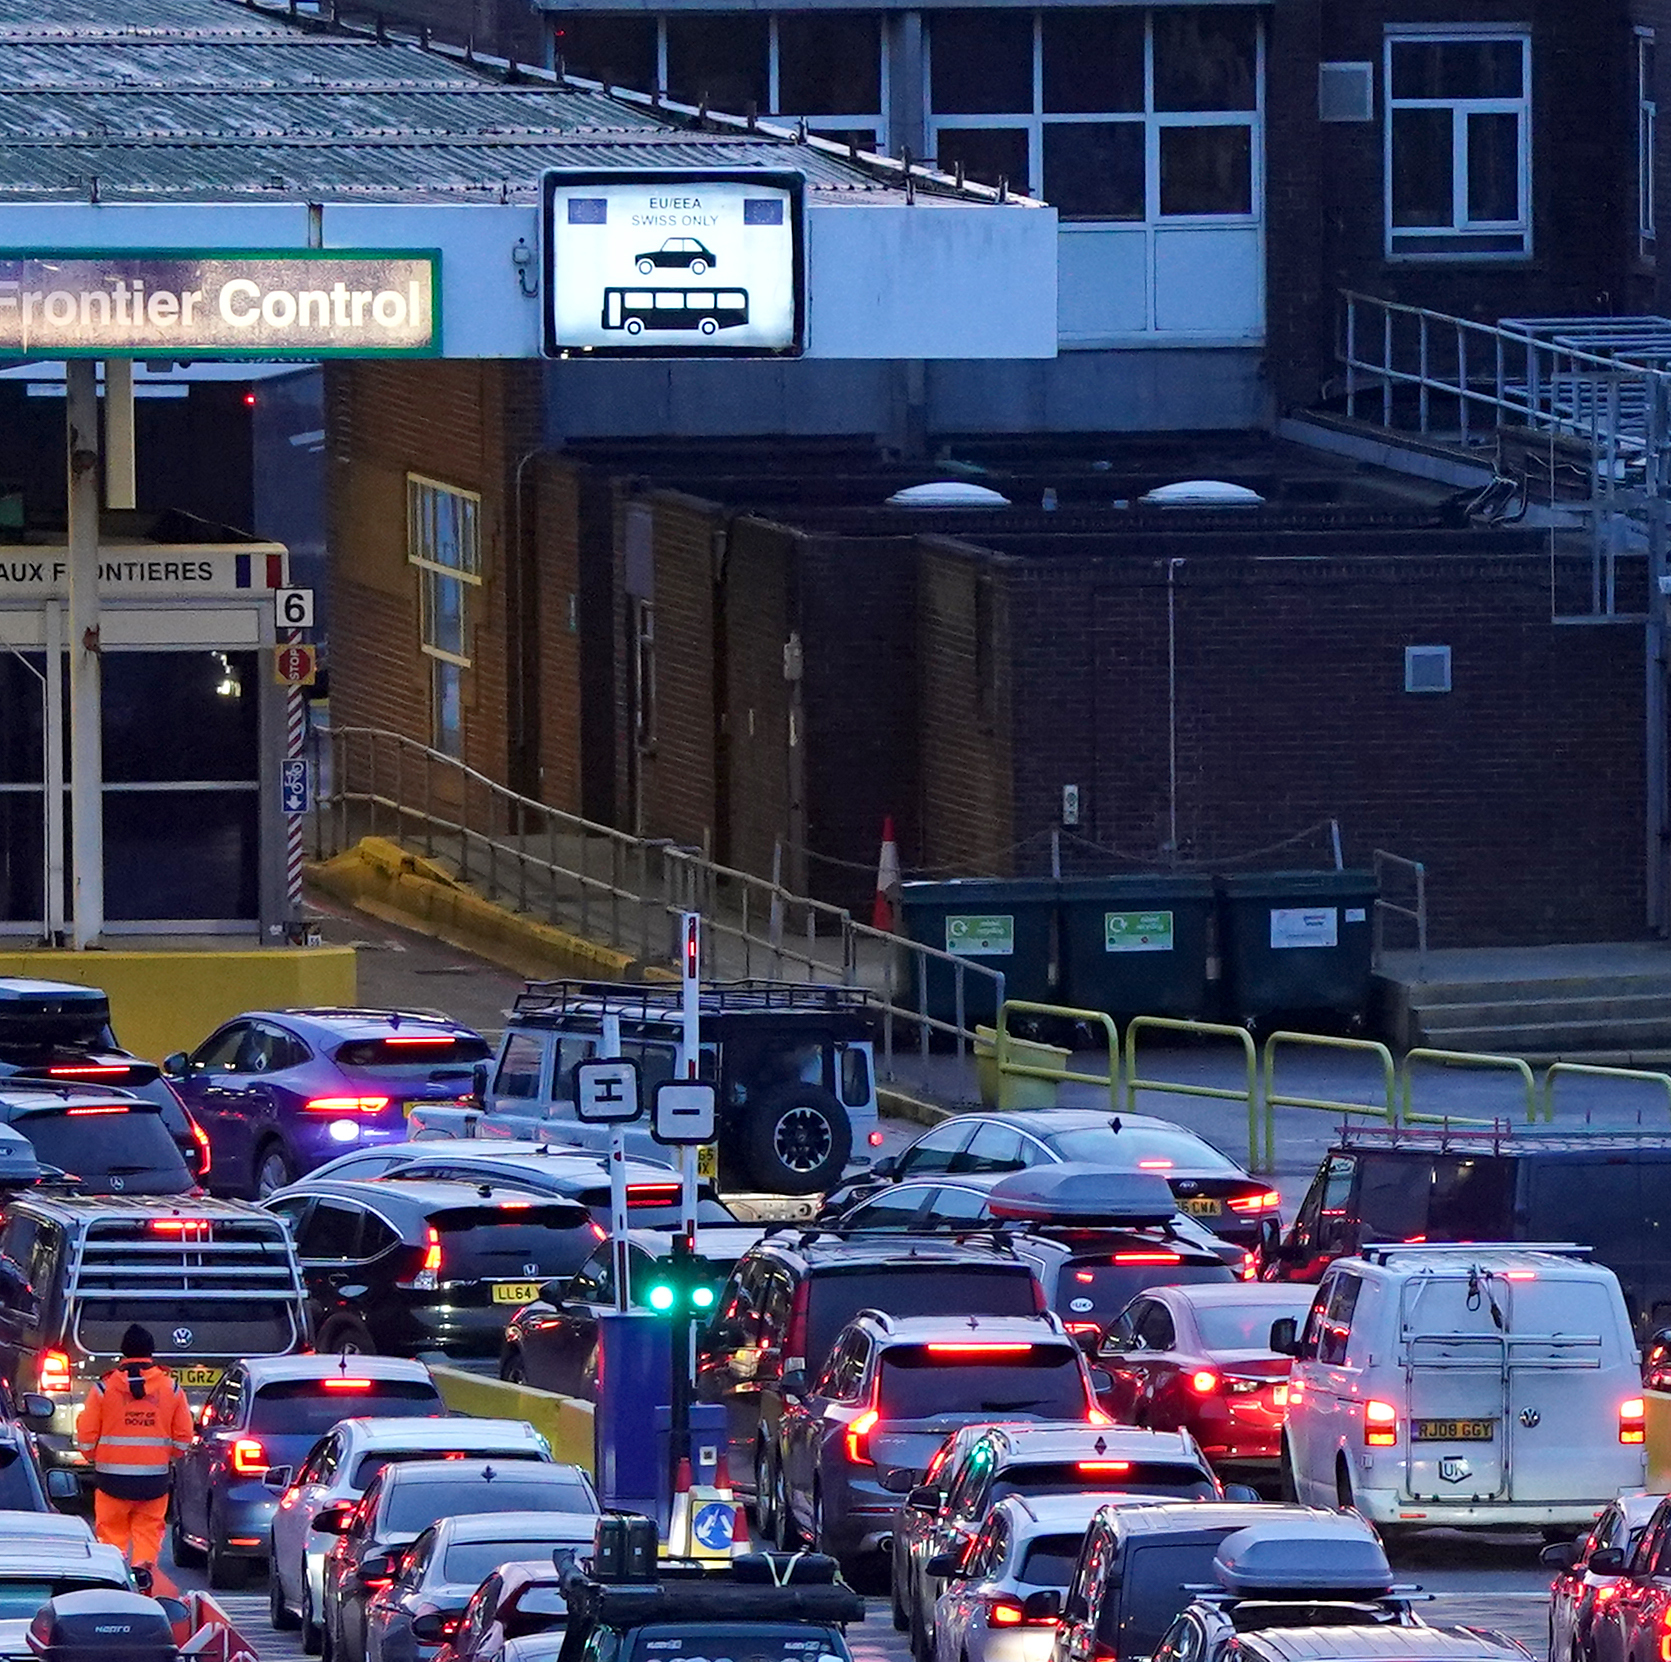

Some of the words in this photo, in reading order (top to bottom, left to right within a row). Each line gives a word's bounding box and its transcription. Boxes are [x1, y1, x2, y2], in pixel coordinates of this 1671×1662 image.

[649, 197, 702, 210] EU/EEA
[631, 215, 677, 226] SWISS
[681, 215, 719, 226] ONLY
[219, 279, 421, 327] Control
[285, 593, 305, 622] 6
[289, 648, 300, 681] STOP
[498, 1286, 532, 1300] LL64
[187, 1370, 215, 1384] GRZ
[125, 1418, 156, 1426] DOVER
[1418, 1422, 1457, 1438] RJ08
[1462, 1421, 1490, 1437] GGY
[1444, 1464, 1464, 1477] UK
